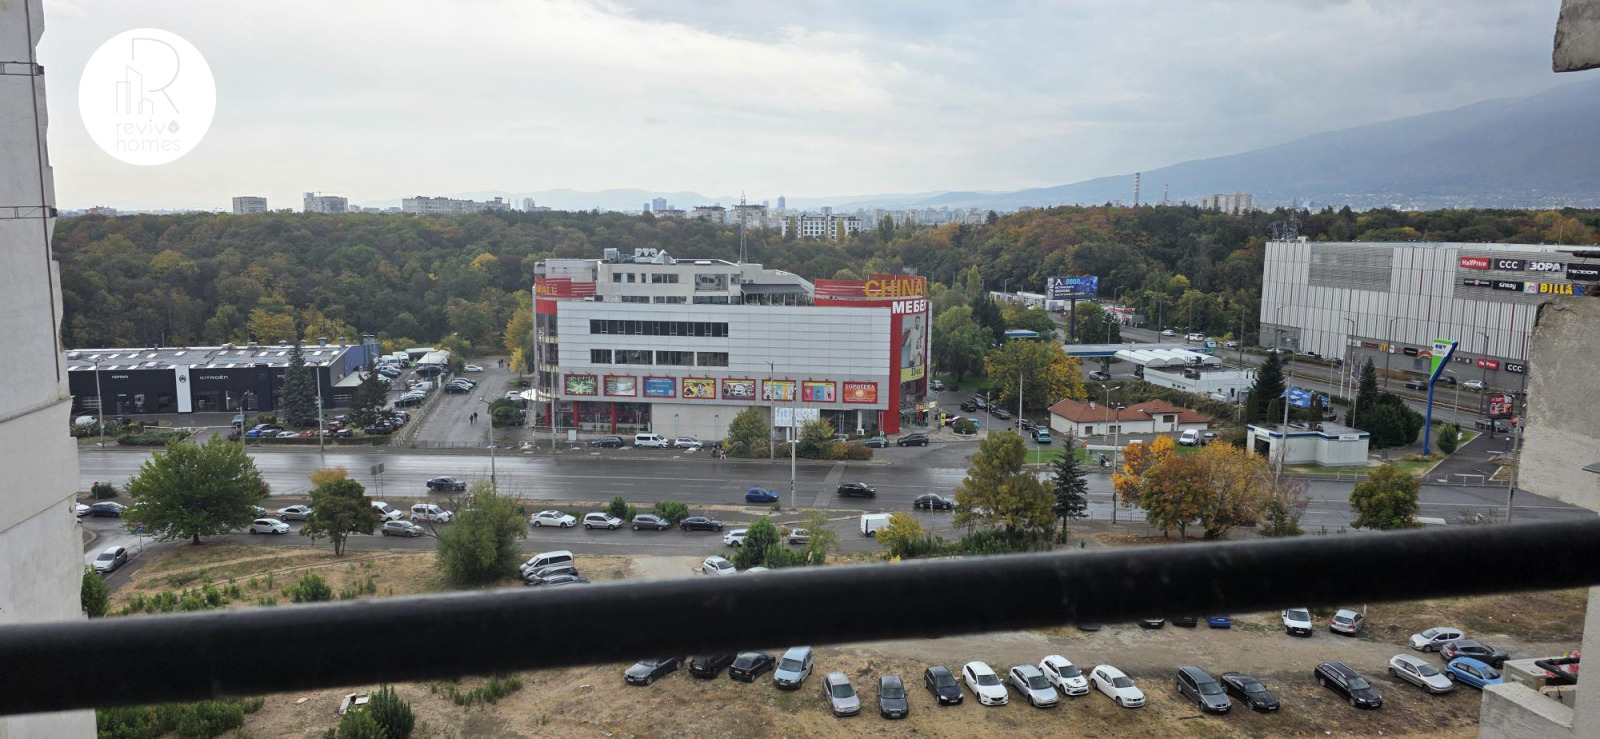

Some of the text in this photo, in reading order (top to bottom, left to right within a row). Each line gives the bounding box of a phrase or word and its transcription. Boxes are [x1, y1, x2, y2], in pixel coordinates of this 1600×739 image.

[1461, 259, 1488, 268] HalfPrice
[1499, 260, 1519, 269] CCC
[864, 278, 924, 298] CHINA
[1540, 282, 1573, 295] BILLA
[1507, 364, 1523, 372] CCC
